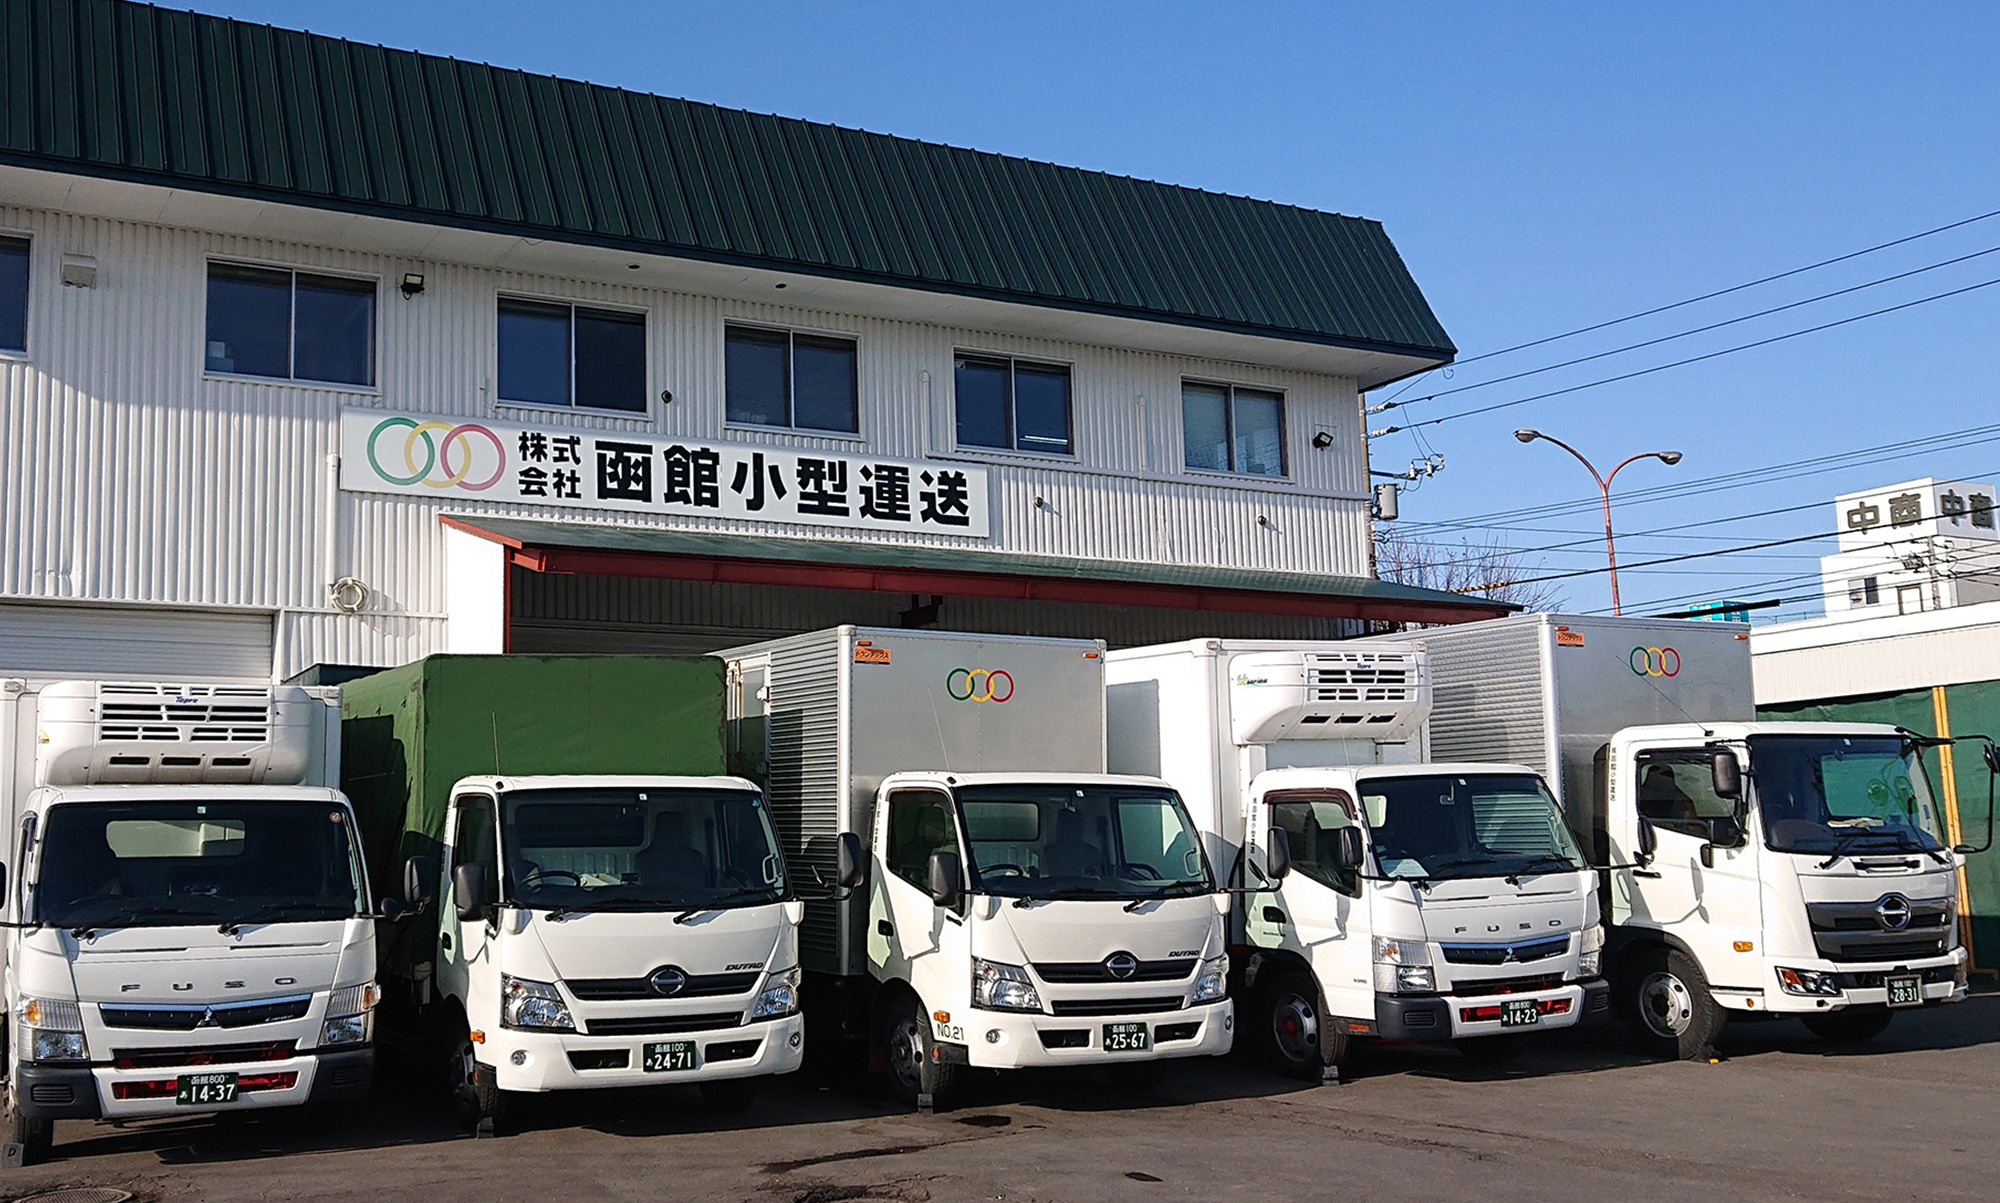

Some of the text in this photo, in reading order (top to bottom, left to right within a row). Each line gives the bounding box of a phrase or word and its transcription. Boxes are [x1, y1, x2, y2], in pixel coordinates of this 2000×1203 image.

[518, 431, 581, 465] 株式
[518, 466, 582, 499] 会社
[595, 440, 970, 527] 函館小型運送
[1847, 493, 1922, 535] 中商
[1454, 919, 1562, 934] FUSO
[724, 962, 764, 971] DUTRO
[120, 977, 297, 993] FUSO
[1509, 1009, 1537, 1025] 14-23
[937, 1023, 964, 1041] NO.21
[1112, 1032, 1146, 1049] 25-67
[654, 1051, 692, 1070] 24-71
[191, 1083, 235, 1103] 14-37
